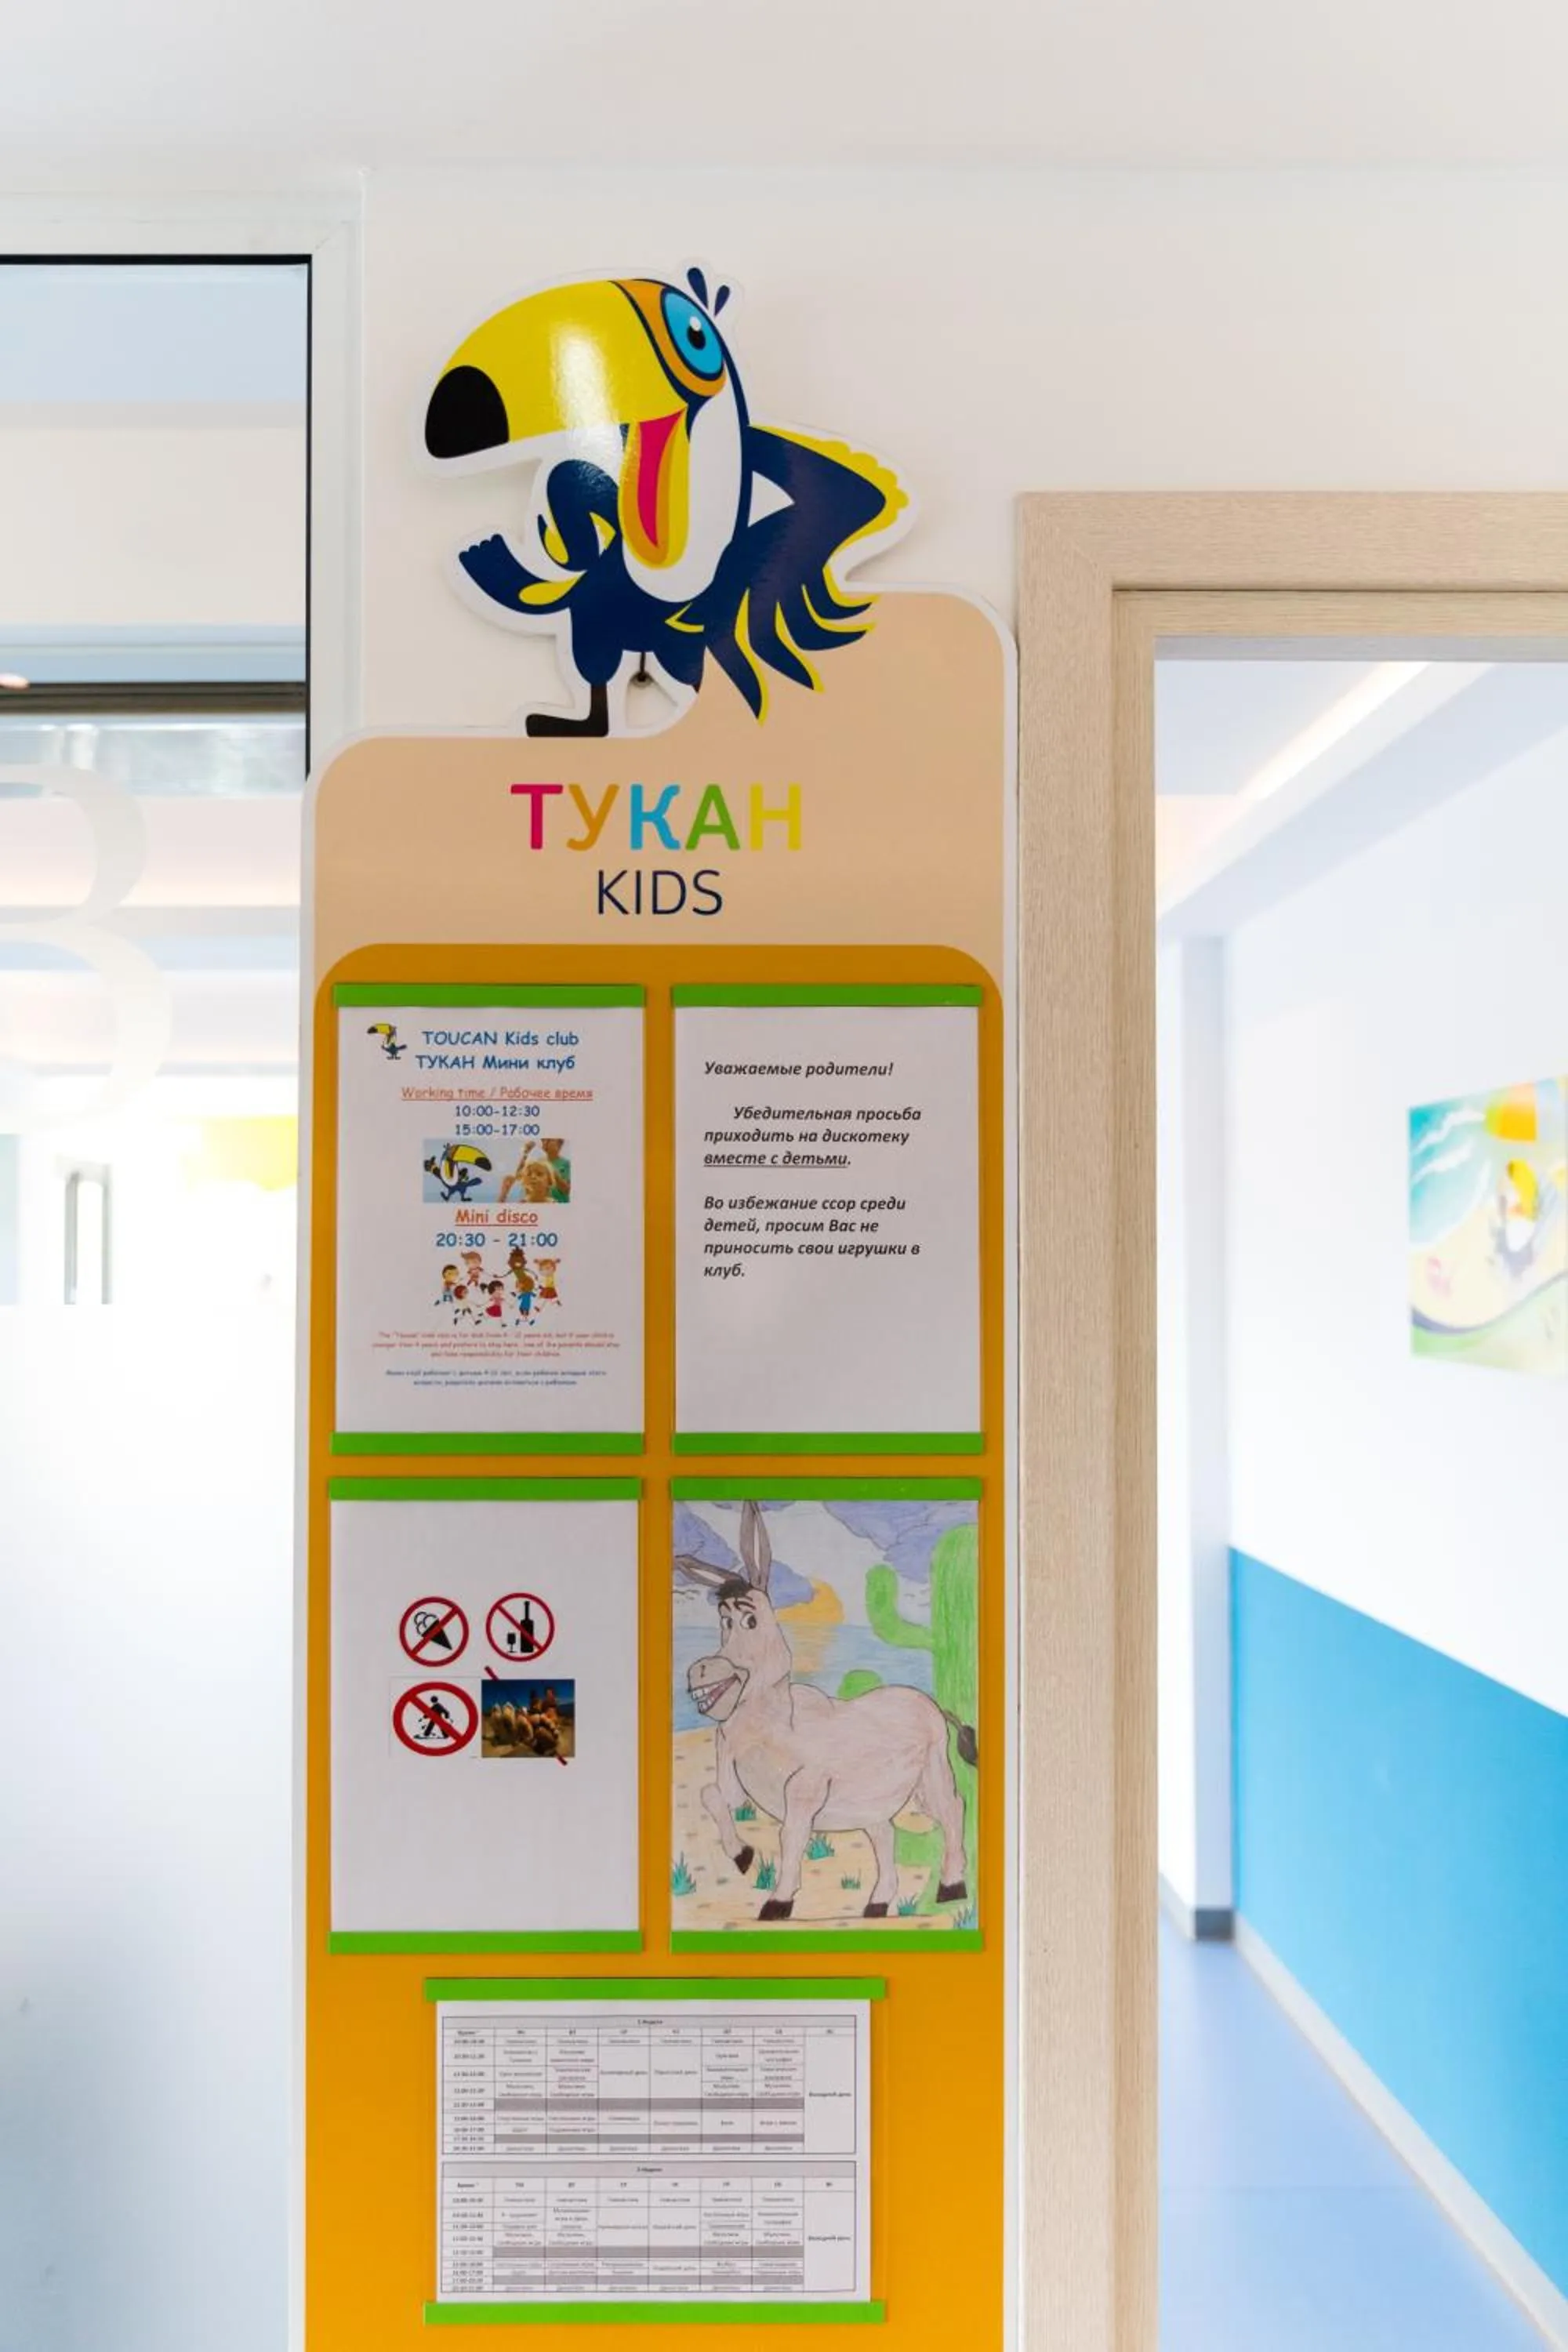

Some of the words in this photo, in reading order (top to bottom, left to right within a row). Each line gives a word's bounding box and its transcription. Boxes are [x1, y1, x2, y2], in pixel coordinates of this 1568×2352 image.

[510, 782, 802, 851] ТУКАН
[597, 869, 723, 915] KIDS
[423, 1031, 497, 1045] TOUCAN
[505, 1031, 539, 1045] Kids
[546, 1031, 579, 1045] club
[416, 1055, 475, 1070] ТУКАН
[482, 1056, 529, 1069] Мини
[537, 1055, 575, 1074] клуб
[704, 1062, 802, 1076] Уважаемые
[806, 1062, 894, 1078] родители!
[401, 1087, 454, 1100] Working
[459, 1087, 485, 1099] time
[500, 1087, 550, 1099] Рабочее
[555, 1090, 593, 1100] время
[455, 1105, 539, 1117] 10:00-12:30
[733, 1107, 851, 1120] Убедительная
[856, 1108, 921, 1123] просьба
[455, 1124, 539, 1136] 15:00-17:00
[704, 1129, 794, 1145] приходить
[799, 1132, 818, 1142] на
[822, 1129, 909, 1145] дискотеку
[704, 1153, 766, 1165] вместе
[771, 1154, 779, 1165] с
[782, 1152, 851, 1165] детьми.
[704, 1196, 724, 1210] Во
[728, 1196, 818, 1210] избежание
[822, 1200, 855, 1213] ссор
[860, 1196, 906, 1213] среди
[456, 1210, 489, 1224] Mini
[496, 1210, 538, 1224] disco
[704, 1219, 760, 1235] детей,
[765, 1221, 824, 1236] просим
[829, 1221, 856, 1232] Вас
[860, 1222, 879, 1232] не
[436, 1233, 485, 1247] 20:30
[508, 1232, 557, 1247] 21:00
[704, 1243, 793, 1257] приносить
[797, 1243, 833, 1254] свои
[838, 1243, 906, 1258] игрушки
[911, 1244, 920, 1254] в
[704, 1263, 745, 1280] клуб.
